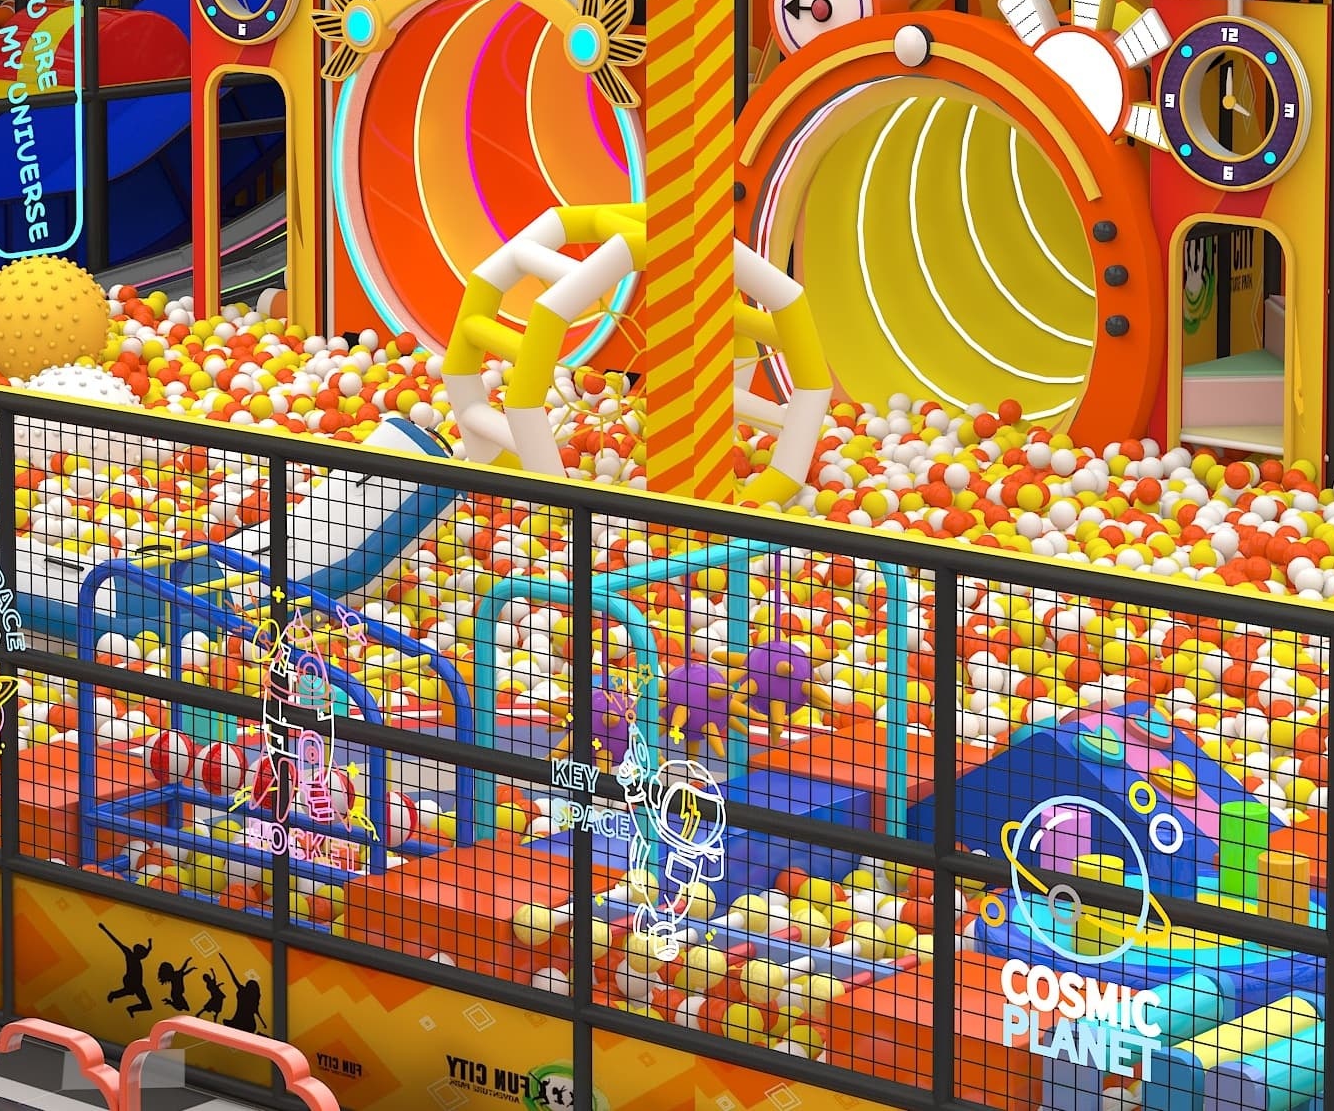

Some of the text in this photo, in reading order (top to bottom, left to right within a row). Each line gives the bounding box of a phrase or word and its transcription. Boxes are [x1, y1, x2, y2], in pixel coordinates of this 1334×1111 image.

[1221, 27, 1239, 42] 12
[31, 30, 57, 91] ARE
[1164, 93, 1175, 108] 9
[1284, 103, 1295, 118] 3
[0, 25, 49, 243] MY UNIVERSE
[1223, 166, 1234, 181] 6
[551, 757, 600, 793] KEY
[551, 798, 631, 841] SPACE
[246, 817, 360, 872] ROCKET
[1001, 958, 1162, 1038] COSMIC
[1002, 1003, 1162, 1082] PLANET
